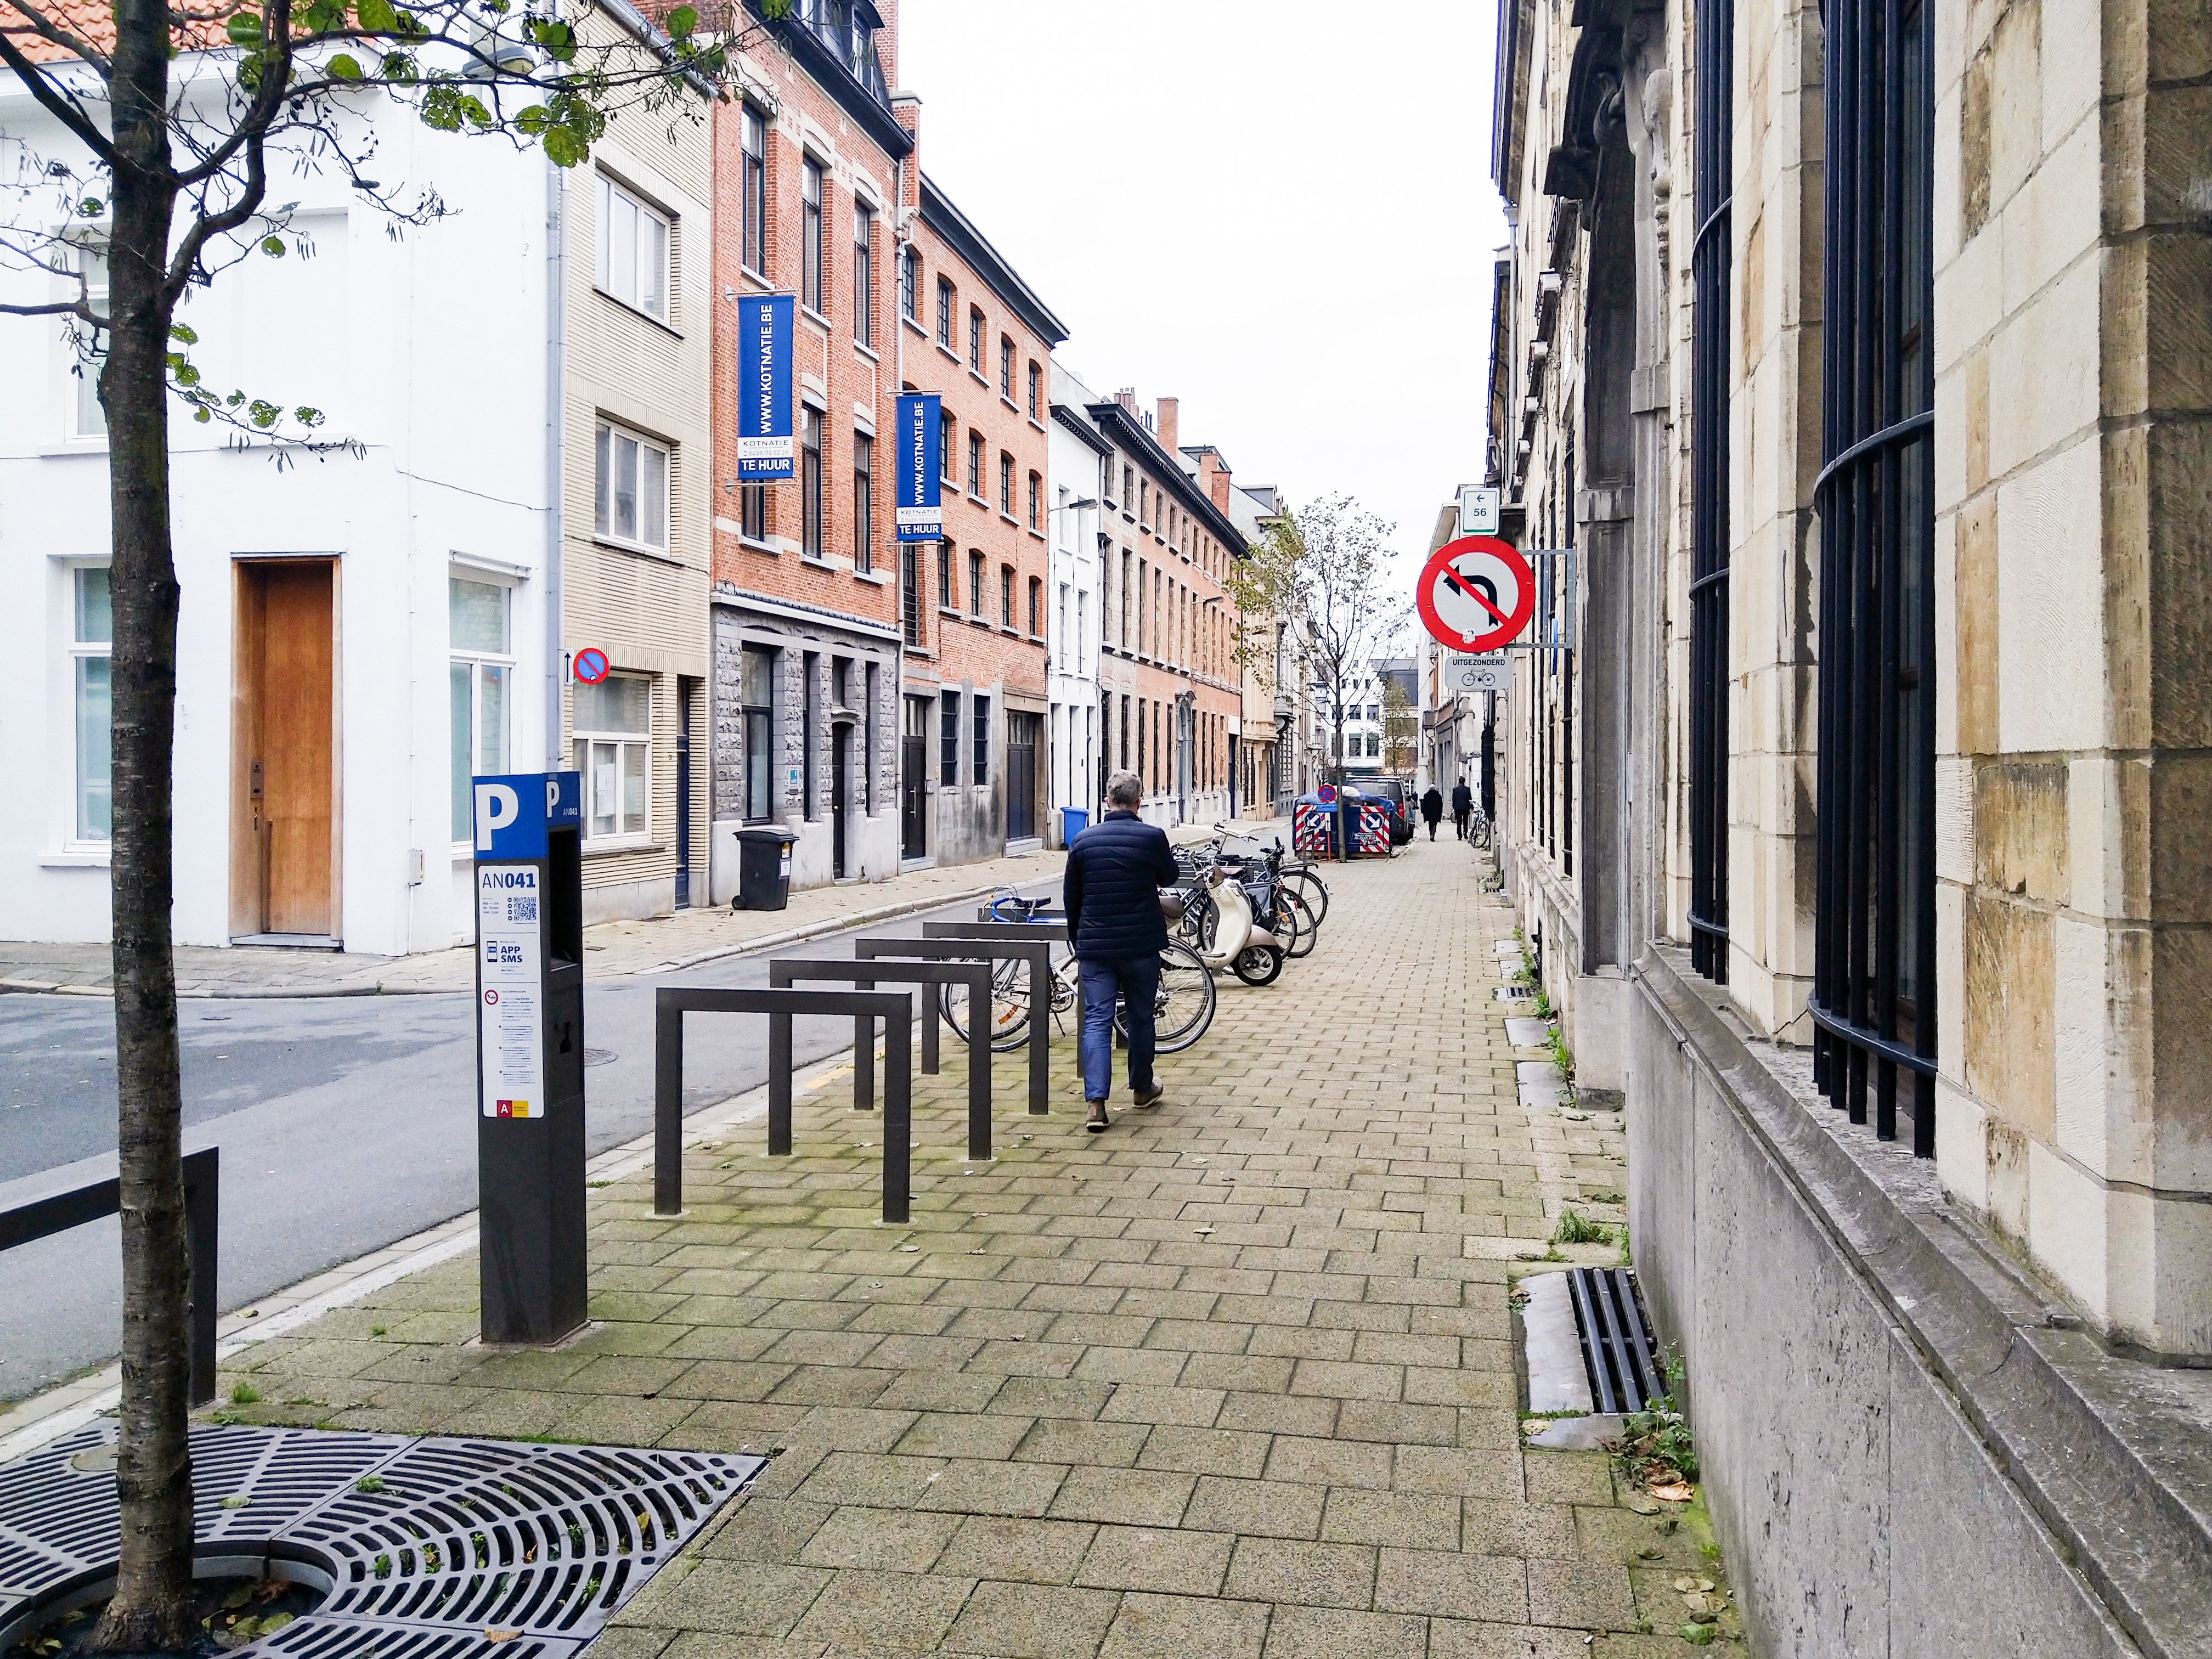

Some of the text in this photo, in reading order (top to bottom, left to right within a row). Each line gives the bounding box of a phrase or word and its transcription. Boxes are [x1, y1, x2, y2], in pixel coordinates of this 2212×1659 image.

[760, 304, 772, 435] WWW.KOTNATIE.BE
[914, 402, 924, 505] WWW.KOTNATIE.BE
[741, 459, 790, 471] TE HUUR
[1474, 508, 1487, 516] 56
[899, 524, 939, 534] TE HUUR
[546, 781, 560, 818] P
[475, 783, 518, 851] P
[563, 807, 578, 816] AN041
[482, 873, 536, 888] AN041
[500, 1104, 509, 1114] A
